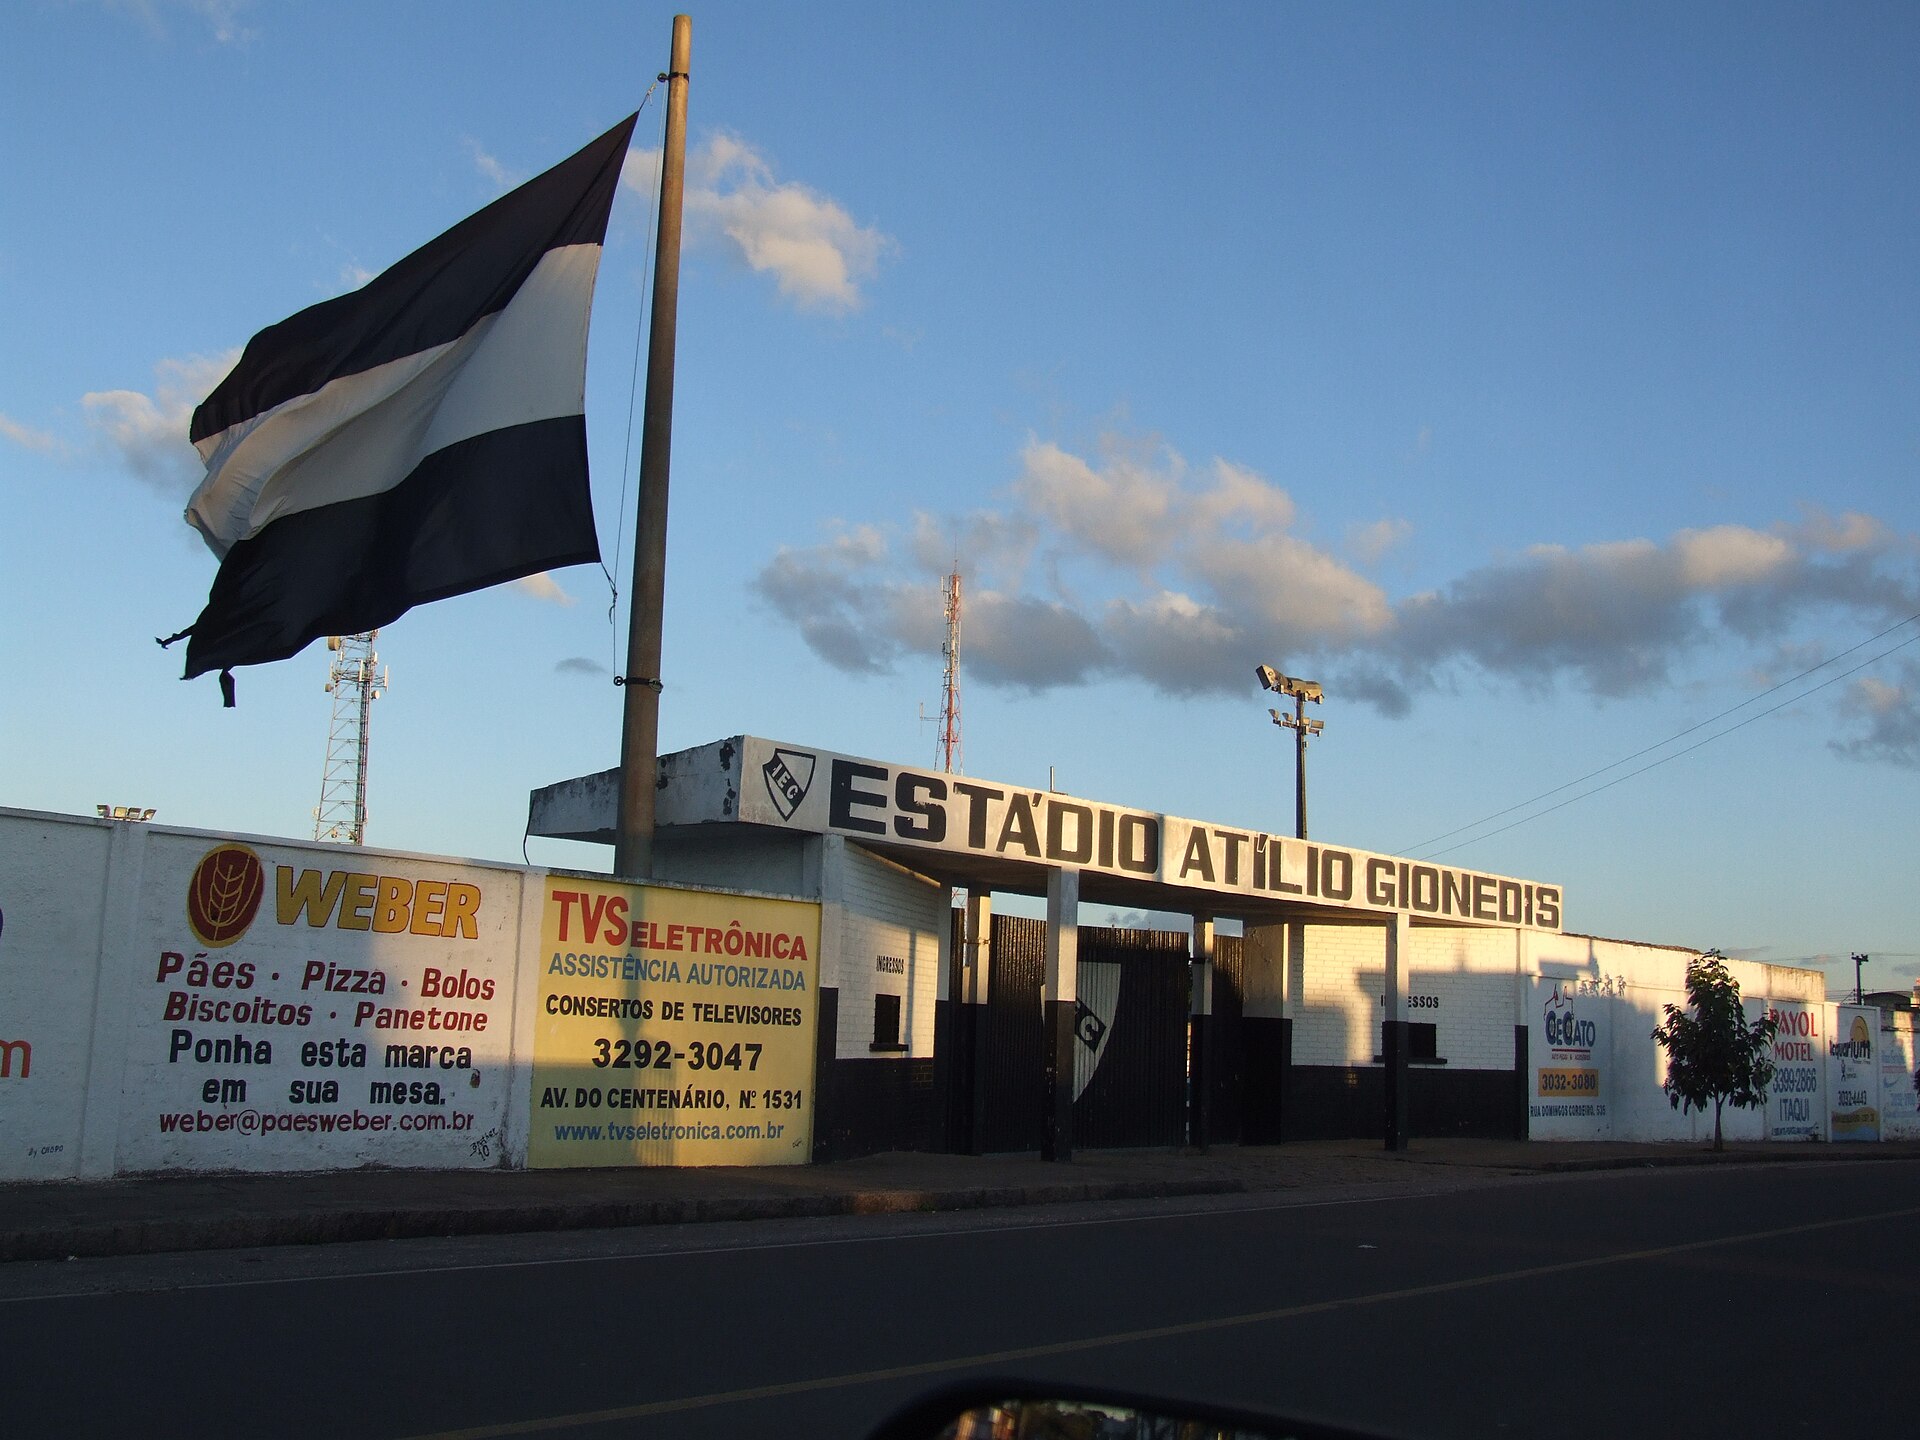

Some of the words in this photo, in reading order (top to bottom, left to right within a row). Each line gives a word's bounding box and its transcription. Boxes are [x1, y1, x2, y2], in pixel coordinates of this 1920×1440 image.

[829, 759, 1159, 874] ESTÁDIO
[1179, 826, 1353, 901] ATÍLIO
[1366, 857, 1560, 930] GIONEDIS
[276, 866, 481, 939] WEBER
[156, 952, 256, 989] Pães
[302, 961, 386, 995] Pizza
[420, 967, 496, 1000] Bolos
[548, 952, 680, 983] ASSISTÊNCIA
[686, 962, 805, 991] AUTORIZADA
[163, 991, 312, 1026] Biscoitos
[354, 1001, 488, 1031] Panetone
[546, 994, 653, 1020] CONSERTOS
[661, 1001, 684, 1021] DE
[692, 1003, 802, 1026] TELEVISORES
[169, 1029, 272, 1064] Ponha
[301, 1038, 366, 1068] esta
[385, 1045, 471, 1069] marca
[591, 1038, 763, 1071] 3292-3047
[1774, 1041, 1813, 1061] MOTEL
[202, 1078, 246, 1103] em
[289, 1079, 338, 1103] sua
[540, 1087, 568, 1108] AV.
[575, 1088, 602, 1108] DO
[607, 1084, 730, 1111] CENTENÁRIO,
[762, 1089, 802, 1109] 1531
[159, 1109, 474, 1136] weber@paesweber.com.br
[1779, 1097, 1809, 1122] ITAQUI
[555, 1121, 784, 1140] www.tvseletronica.com.br
